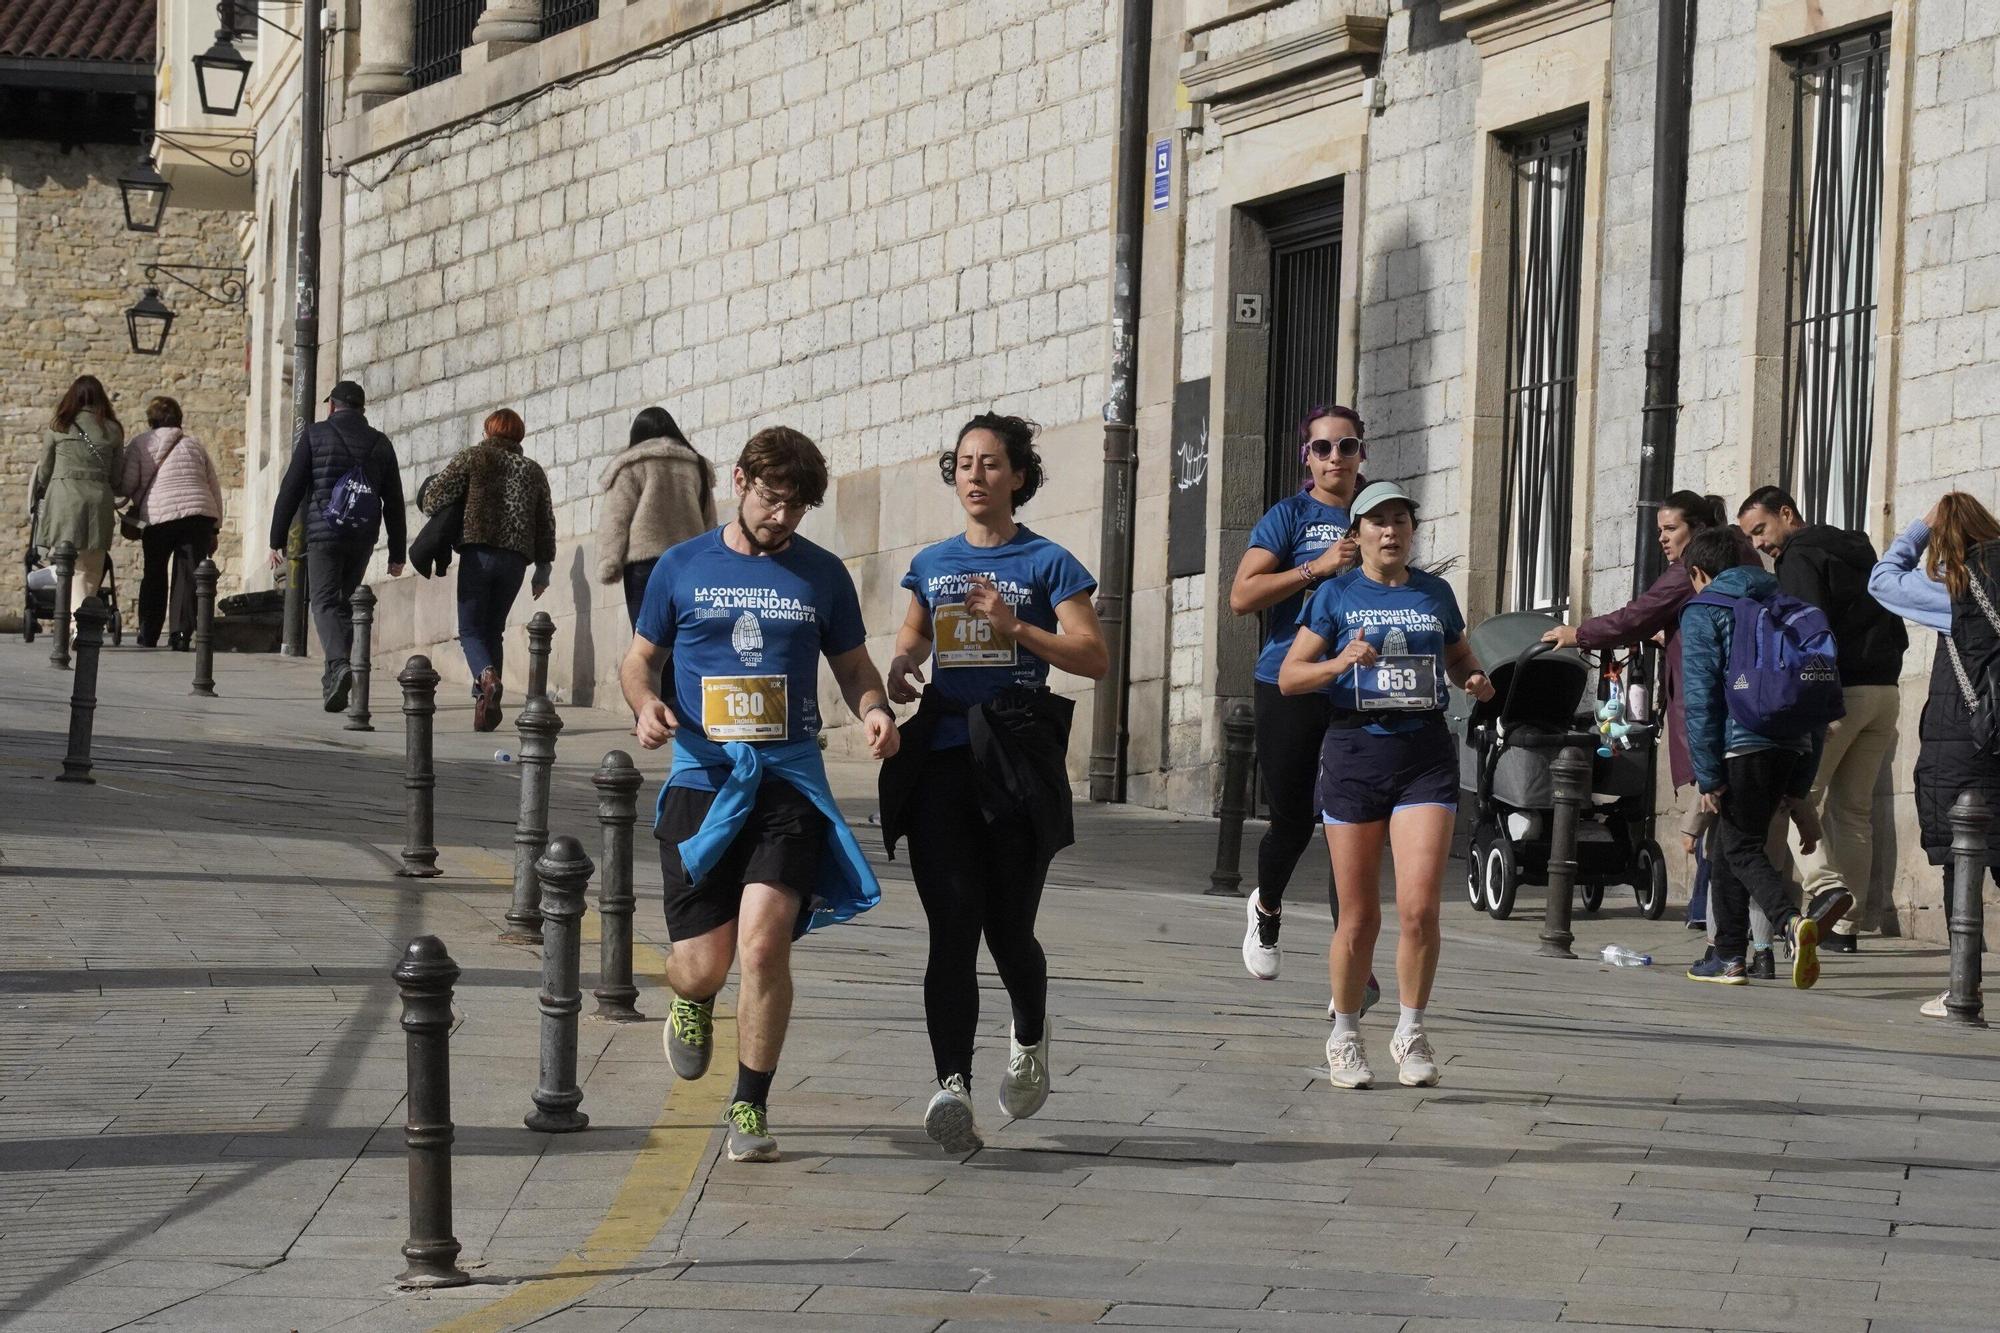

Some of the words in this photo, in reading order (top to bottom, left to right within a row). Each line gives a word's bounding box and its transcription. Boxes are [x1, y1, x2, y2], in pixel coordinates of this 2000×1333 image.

[1241, 298, 1256, 319] 5
[1306, 525, 1317, 533] LA
[928, 577, 939, 586] LA
[940, 581, 1018, 596] ALMEDRA
[694, 587, 709, 597] LA
[710, 587, 778, 598] CONQUISTA
[1001, 593, 1032, 605] KISTA
[712, 596, 802, 610] ALMENDRA
[802, 605, 816, 613] REN
[761, 609, 816, 623] KONKISTA
[1346, 611, 1358, 620] LA
[1359, 609, 1418, 618] CONQUISTA
[1363, 614, 1438, 627] ALMENDRA
[954, 619, 991, 642] 415
[1377, 668, 1417, 691] 853
[724, 692, 764, 717] 130
